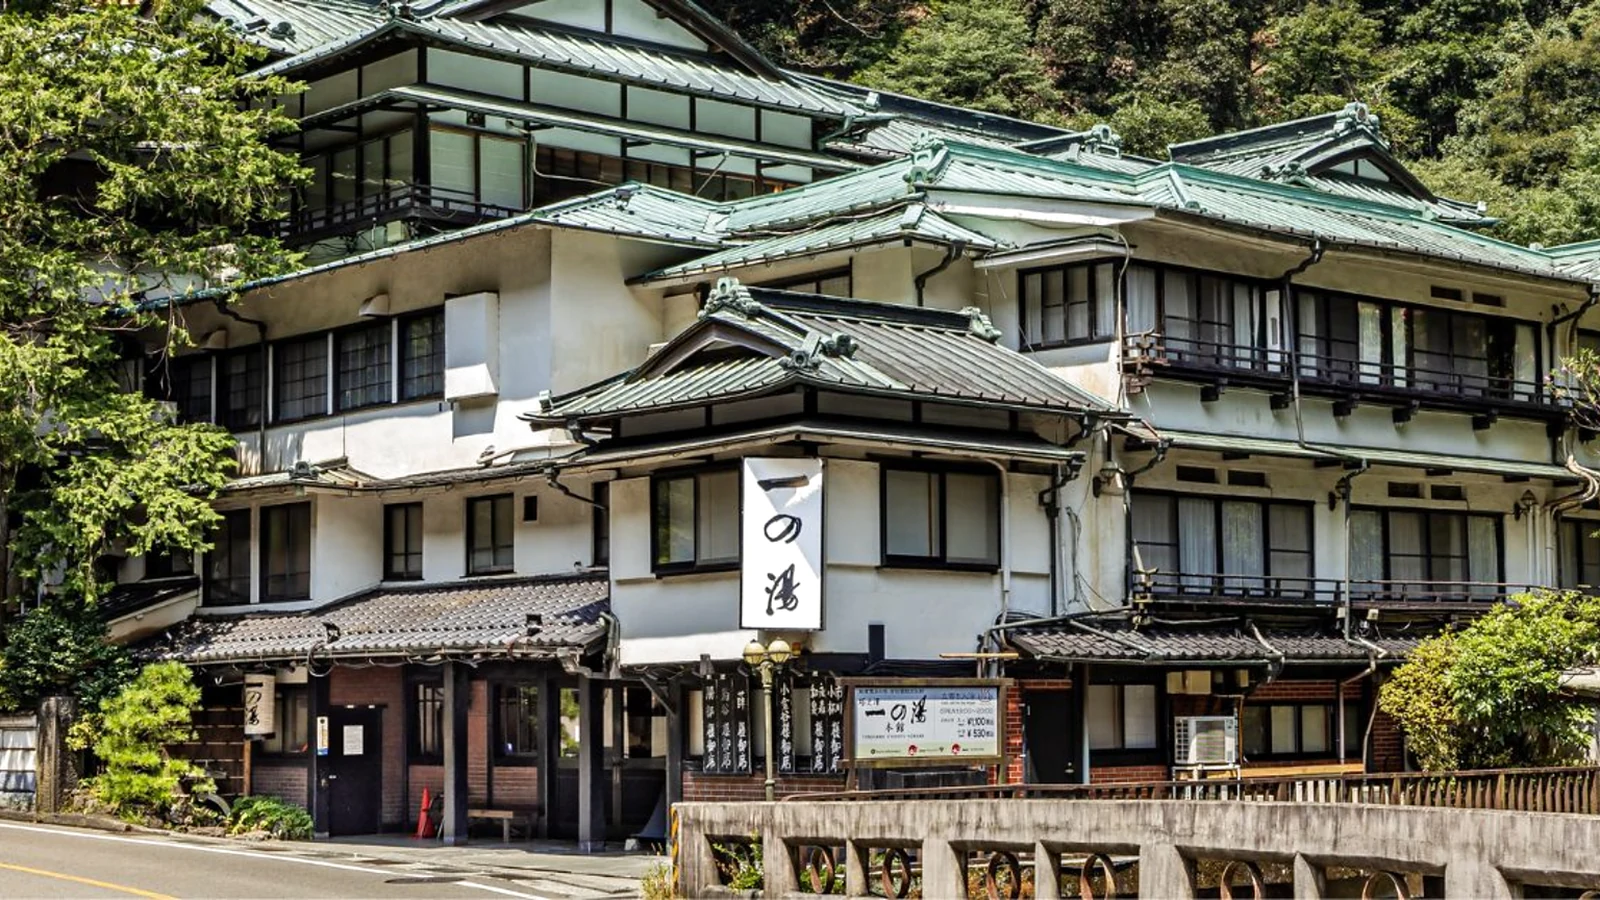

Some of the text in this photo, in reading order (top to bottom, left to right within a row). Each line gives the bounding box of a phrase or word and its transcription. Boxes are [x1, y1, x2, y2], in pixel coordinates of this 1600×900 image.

[757, 474, 810, 616] 一の湯
[865, 694, 927, 724] 一の湯
